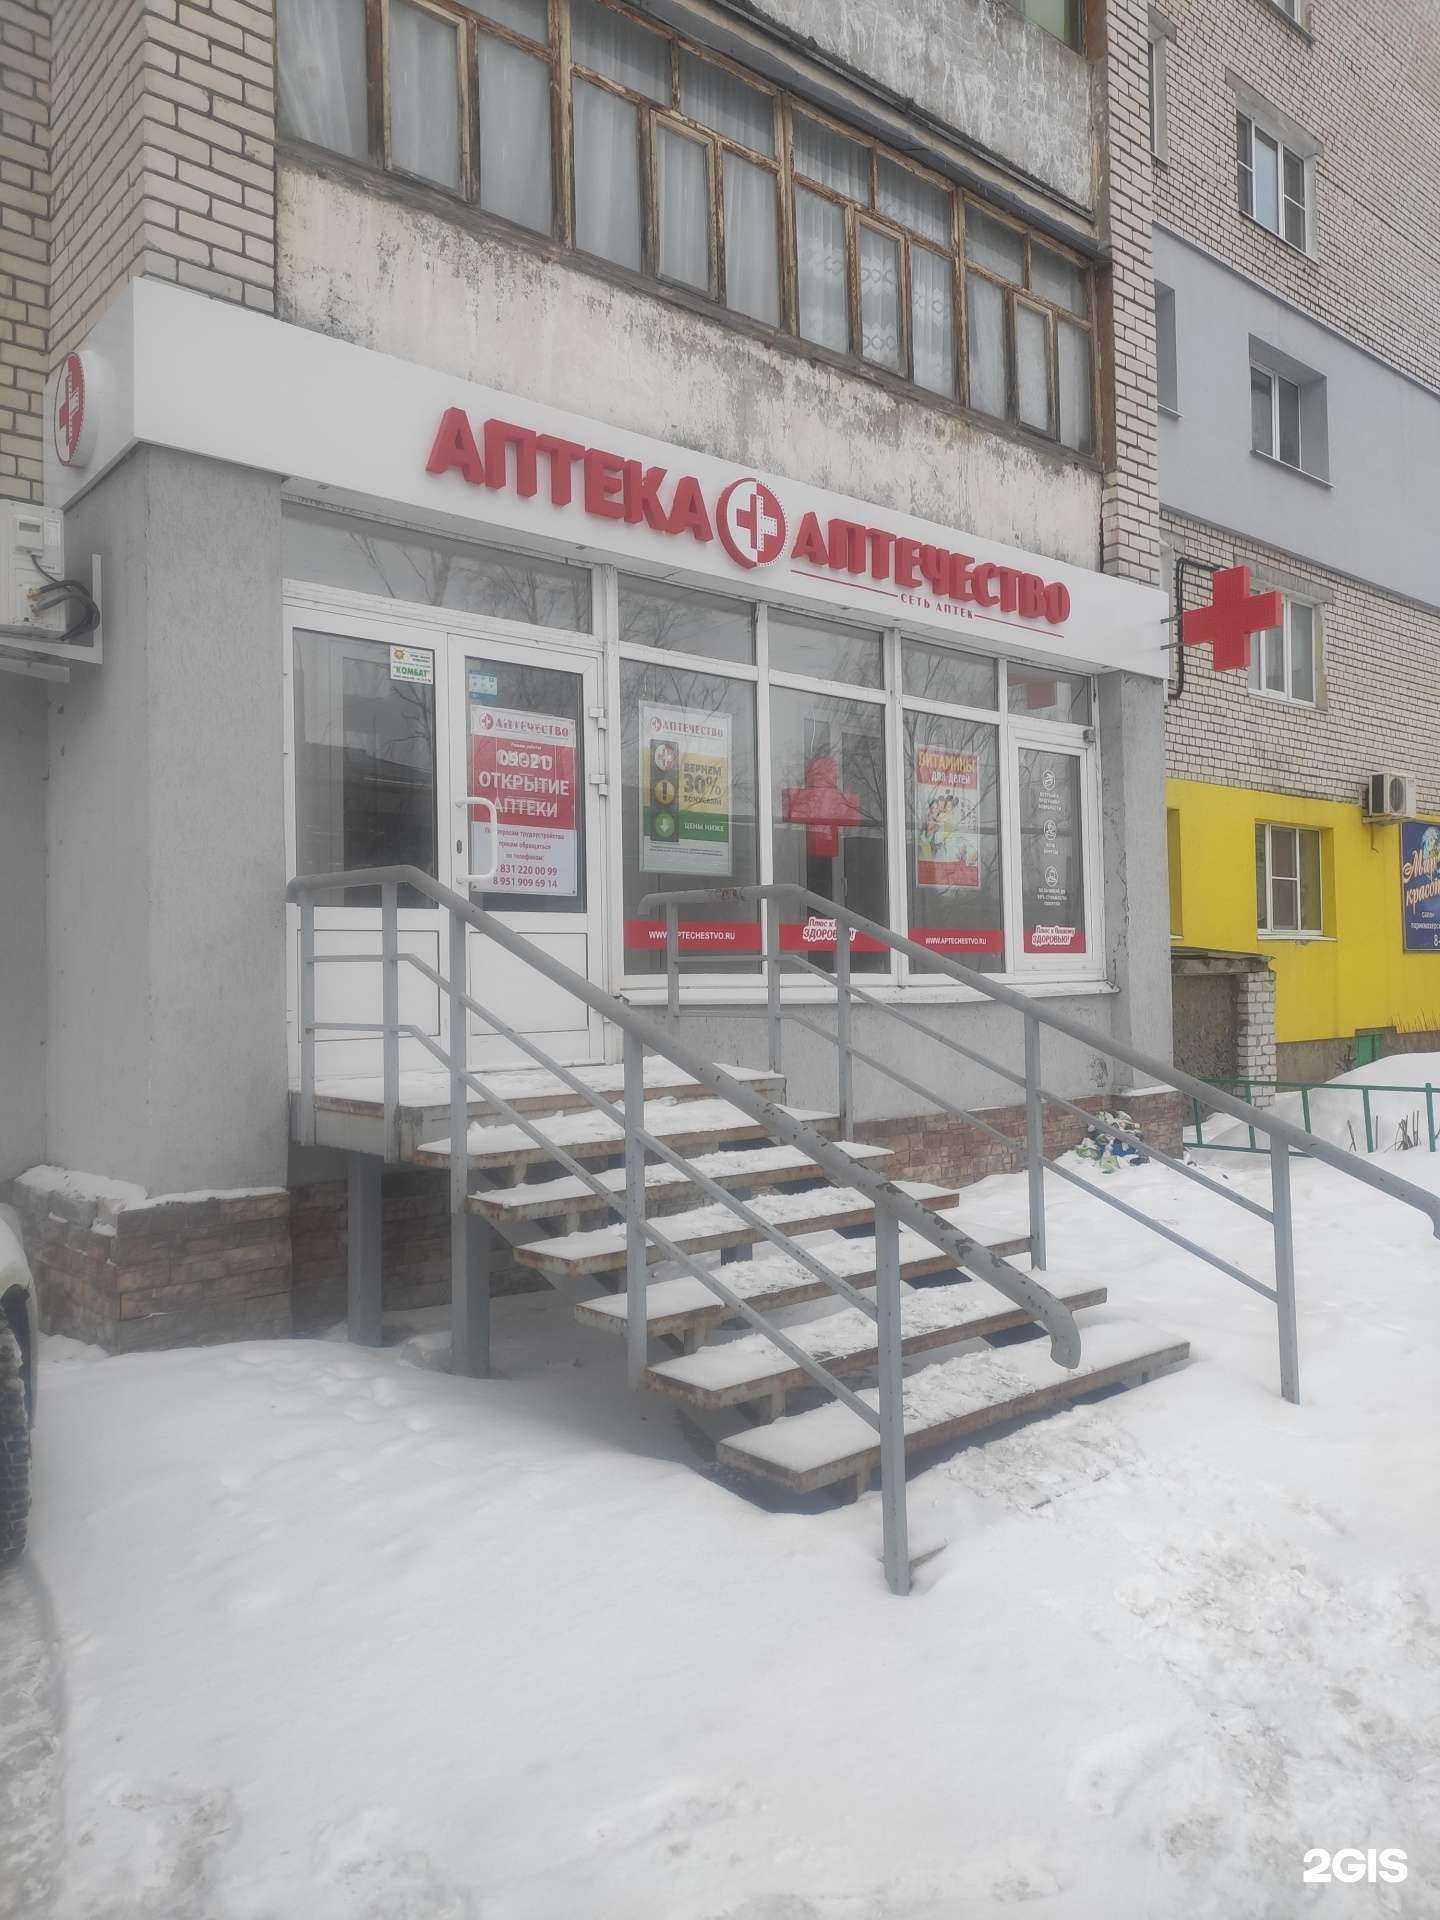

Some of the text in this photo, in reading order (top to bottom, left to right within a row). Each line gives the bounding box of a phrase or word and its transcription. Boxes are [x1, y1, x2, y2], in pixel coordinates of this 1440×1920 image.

[425, 406, 1072, 625] АПТЕКА АПТЕЧЕСТВО
[900, 594, 975, 619] СЕТЬ АПТЕК
[662, 720, 724, 738] АПТЕЧЕСТВО
[479, 770, 570, 797] ОТКРЫТИЕ
[683, 772, 722, 797] 30%
[494, 796, 558, 818] АПТЕКИ
[500, 864, 558, 877] 831 220 00 99
[1402, 849, 1437, 883] Мир
[518, 878, 533, 888] 909
[535, 879, 545, 889] 69
[548, 879, 558, 890] 14
[810, 918, 828, 927] Плюс
[649, 930, 735, 940] WWWPTECHESTVO.RU
[925, 937, 987, 945] WWW.APTECHESTVO.RU
